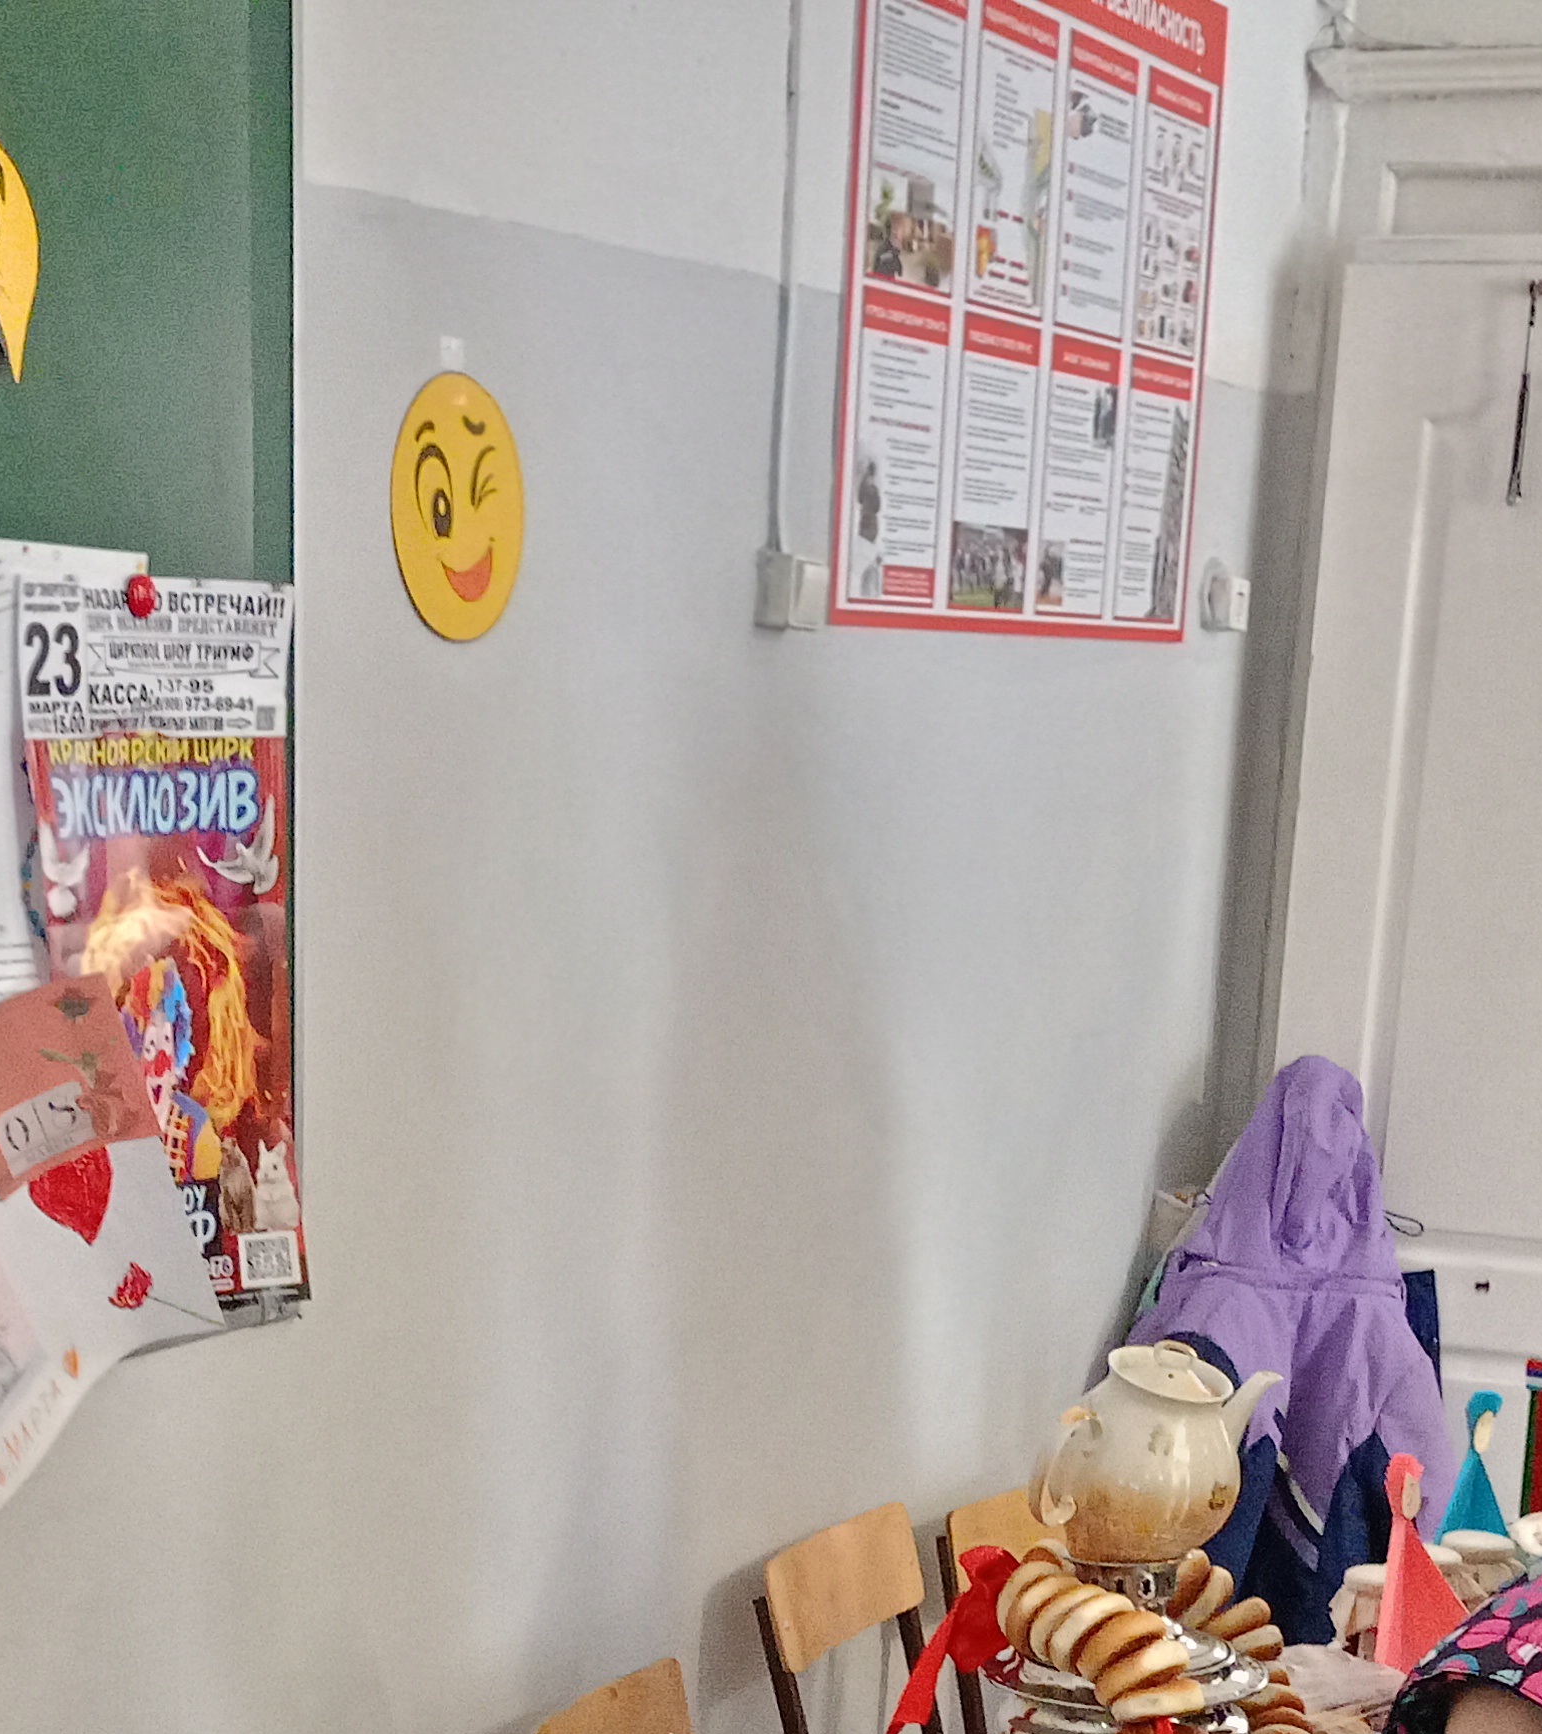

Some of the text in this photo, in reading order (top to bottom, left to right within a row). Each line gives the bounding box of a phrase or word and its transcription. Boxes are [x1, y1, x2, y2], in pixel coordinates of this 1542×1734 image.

[83, 587, 162, 612] НАЗАРО
[25, 622, 82, 697] 23
[196, 642, 254, 662] ТРИУМФ
[28, 701, 84, 714] МАРТА
[194, 737, 254, 765] ЦИРК
[51, 769, 259, 839] ЭКСКЛЮЗИВ
